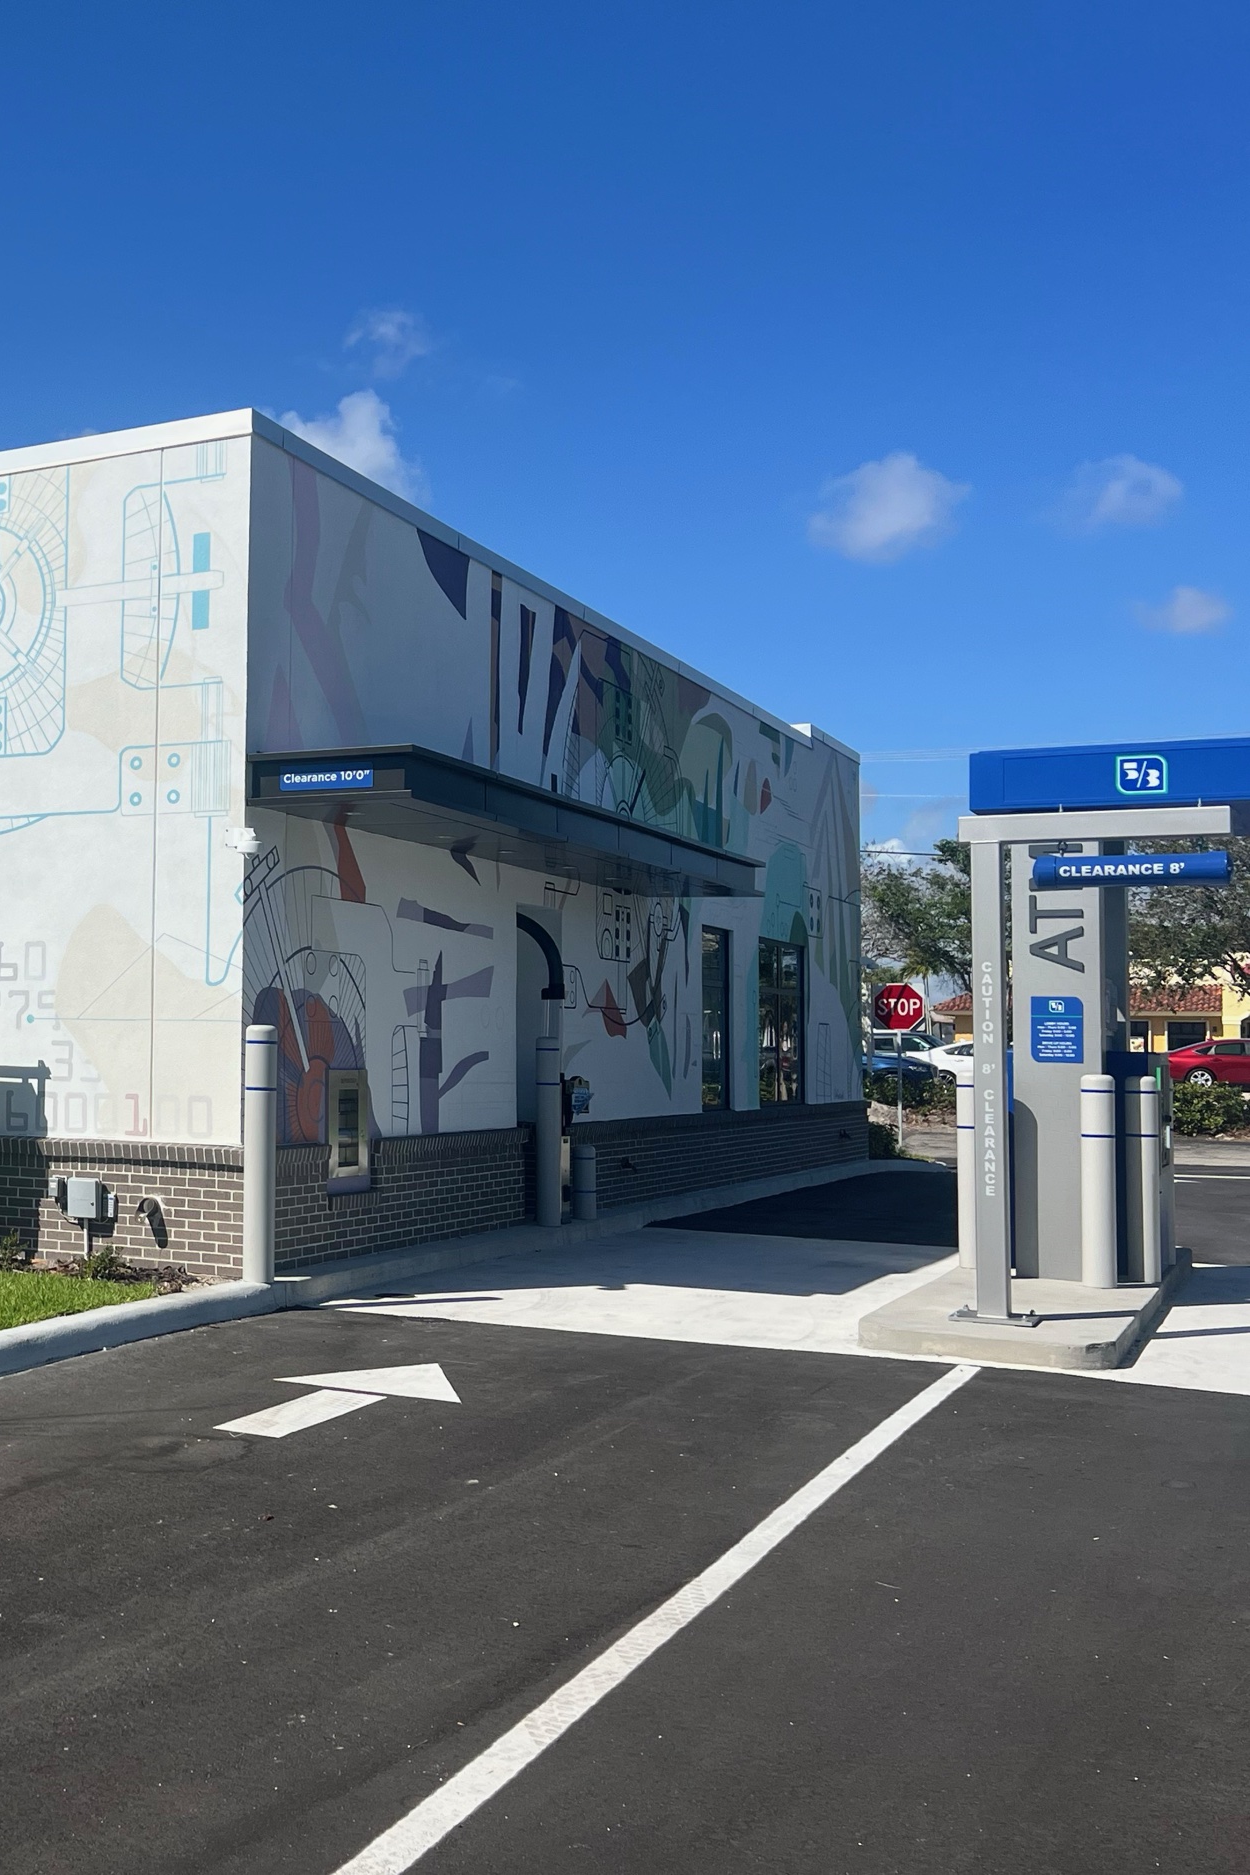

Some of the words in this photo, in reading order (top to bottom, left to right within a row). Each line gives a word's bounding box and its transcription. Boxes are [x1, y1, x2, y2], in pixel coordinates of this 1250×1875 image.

[283, 772, 337, 784] Clearance
[1059, 863, 1164, 878] CLEARANCE
[1170, 862, 1185, 875] 8'
[877, 998, 921, 1016] STOP
[981, 962, 994, 1044] CAUTION
[983, 1089, 996, 1197] CLEARANCE
